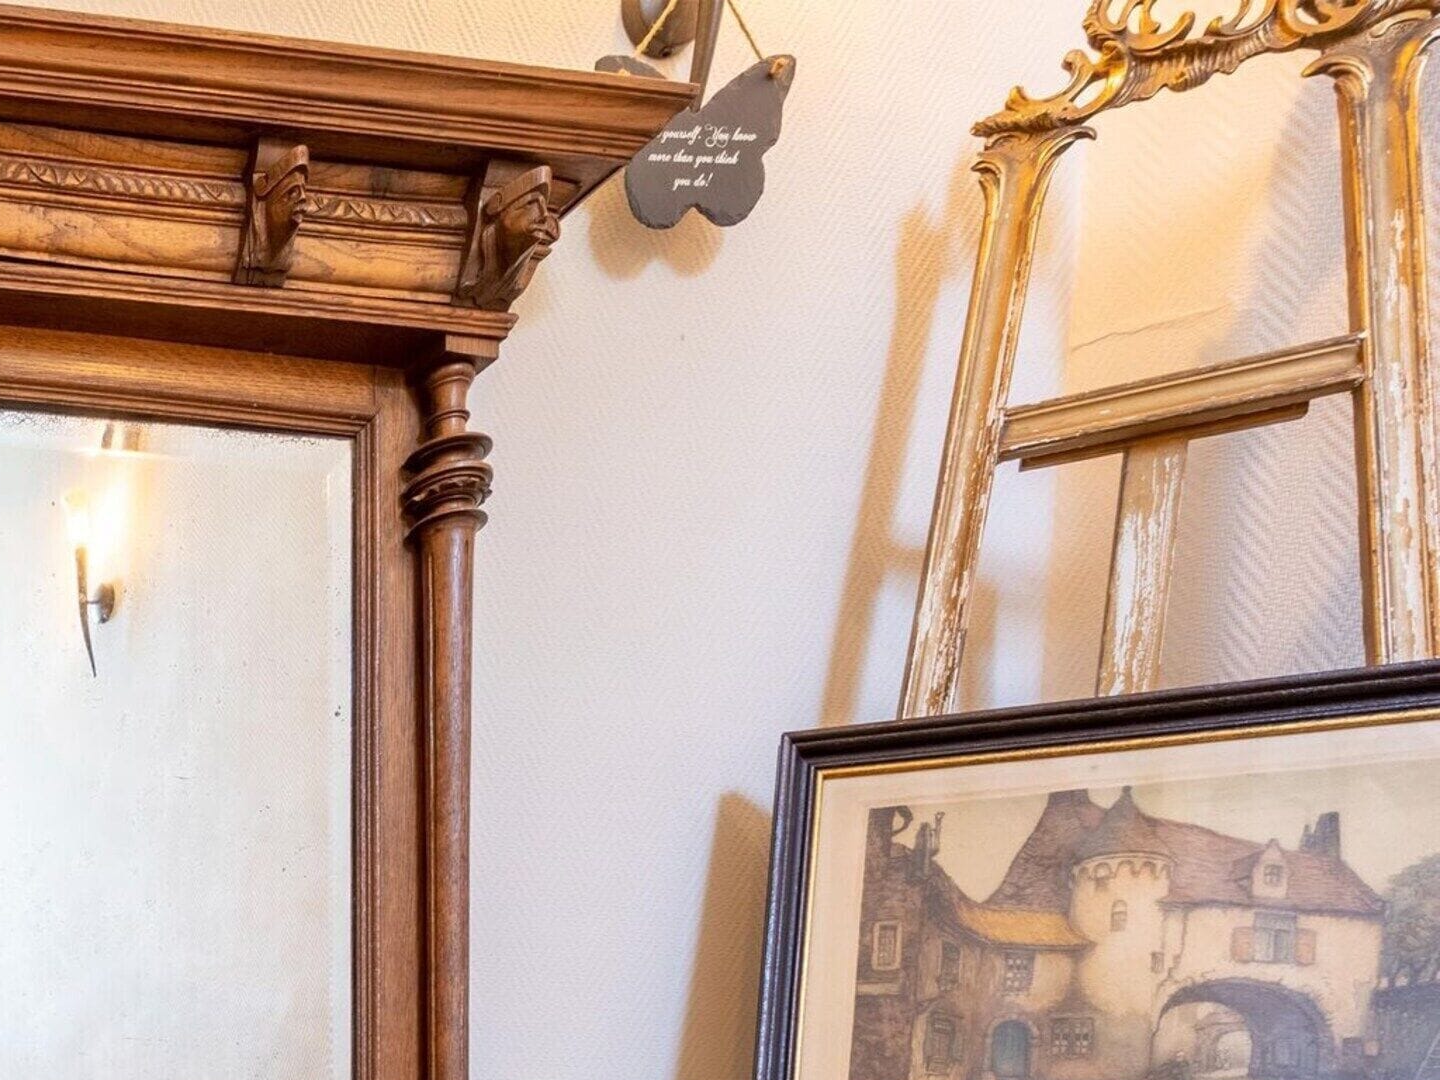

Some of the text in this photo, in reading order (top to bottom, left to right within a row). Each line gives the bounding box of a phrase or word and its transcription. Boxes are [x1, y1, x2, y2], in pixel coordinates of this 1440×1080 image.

[661, 125, 702, 145] yourself.
[705, 124, 730, 148] You
[647, 150, 740, 168] more than you think
[673, 173, 713, 191] you do!
